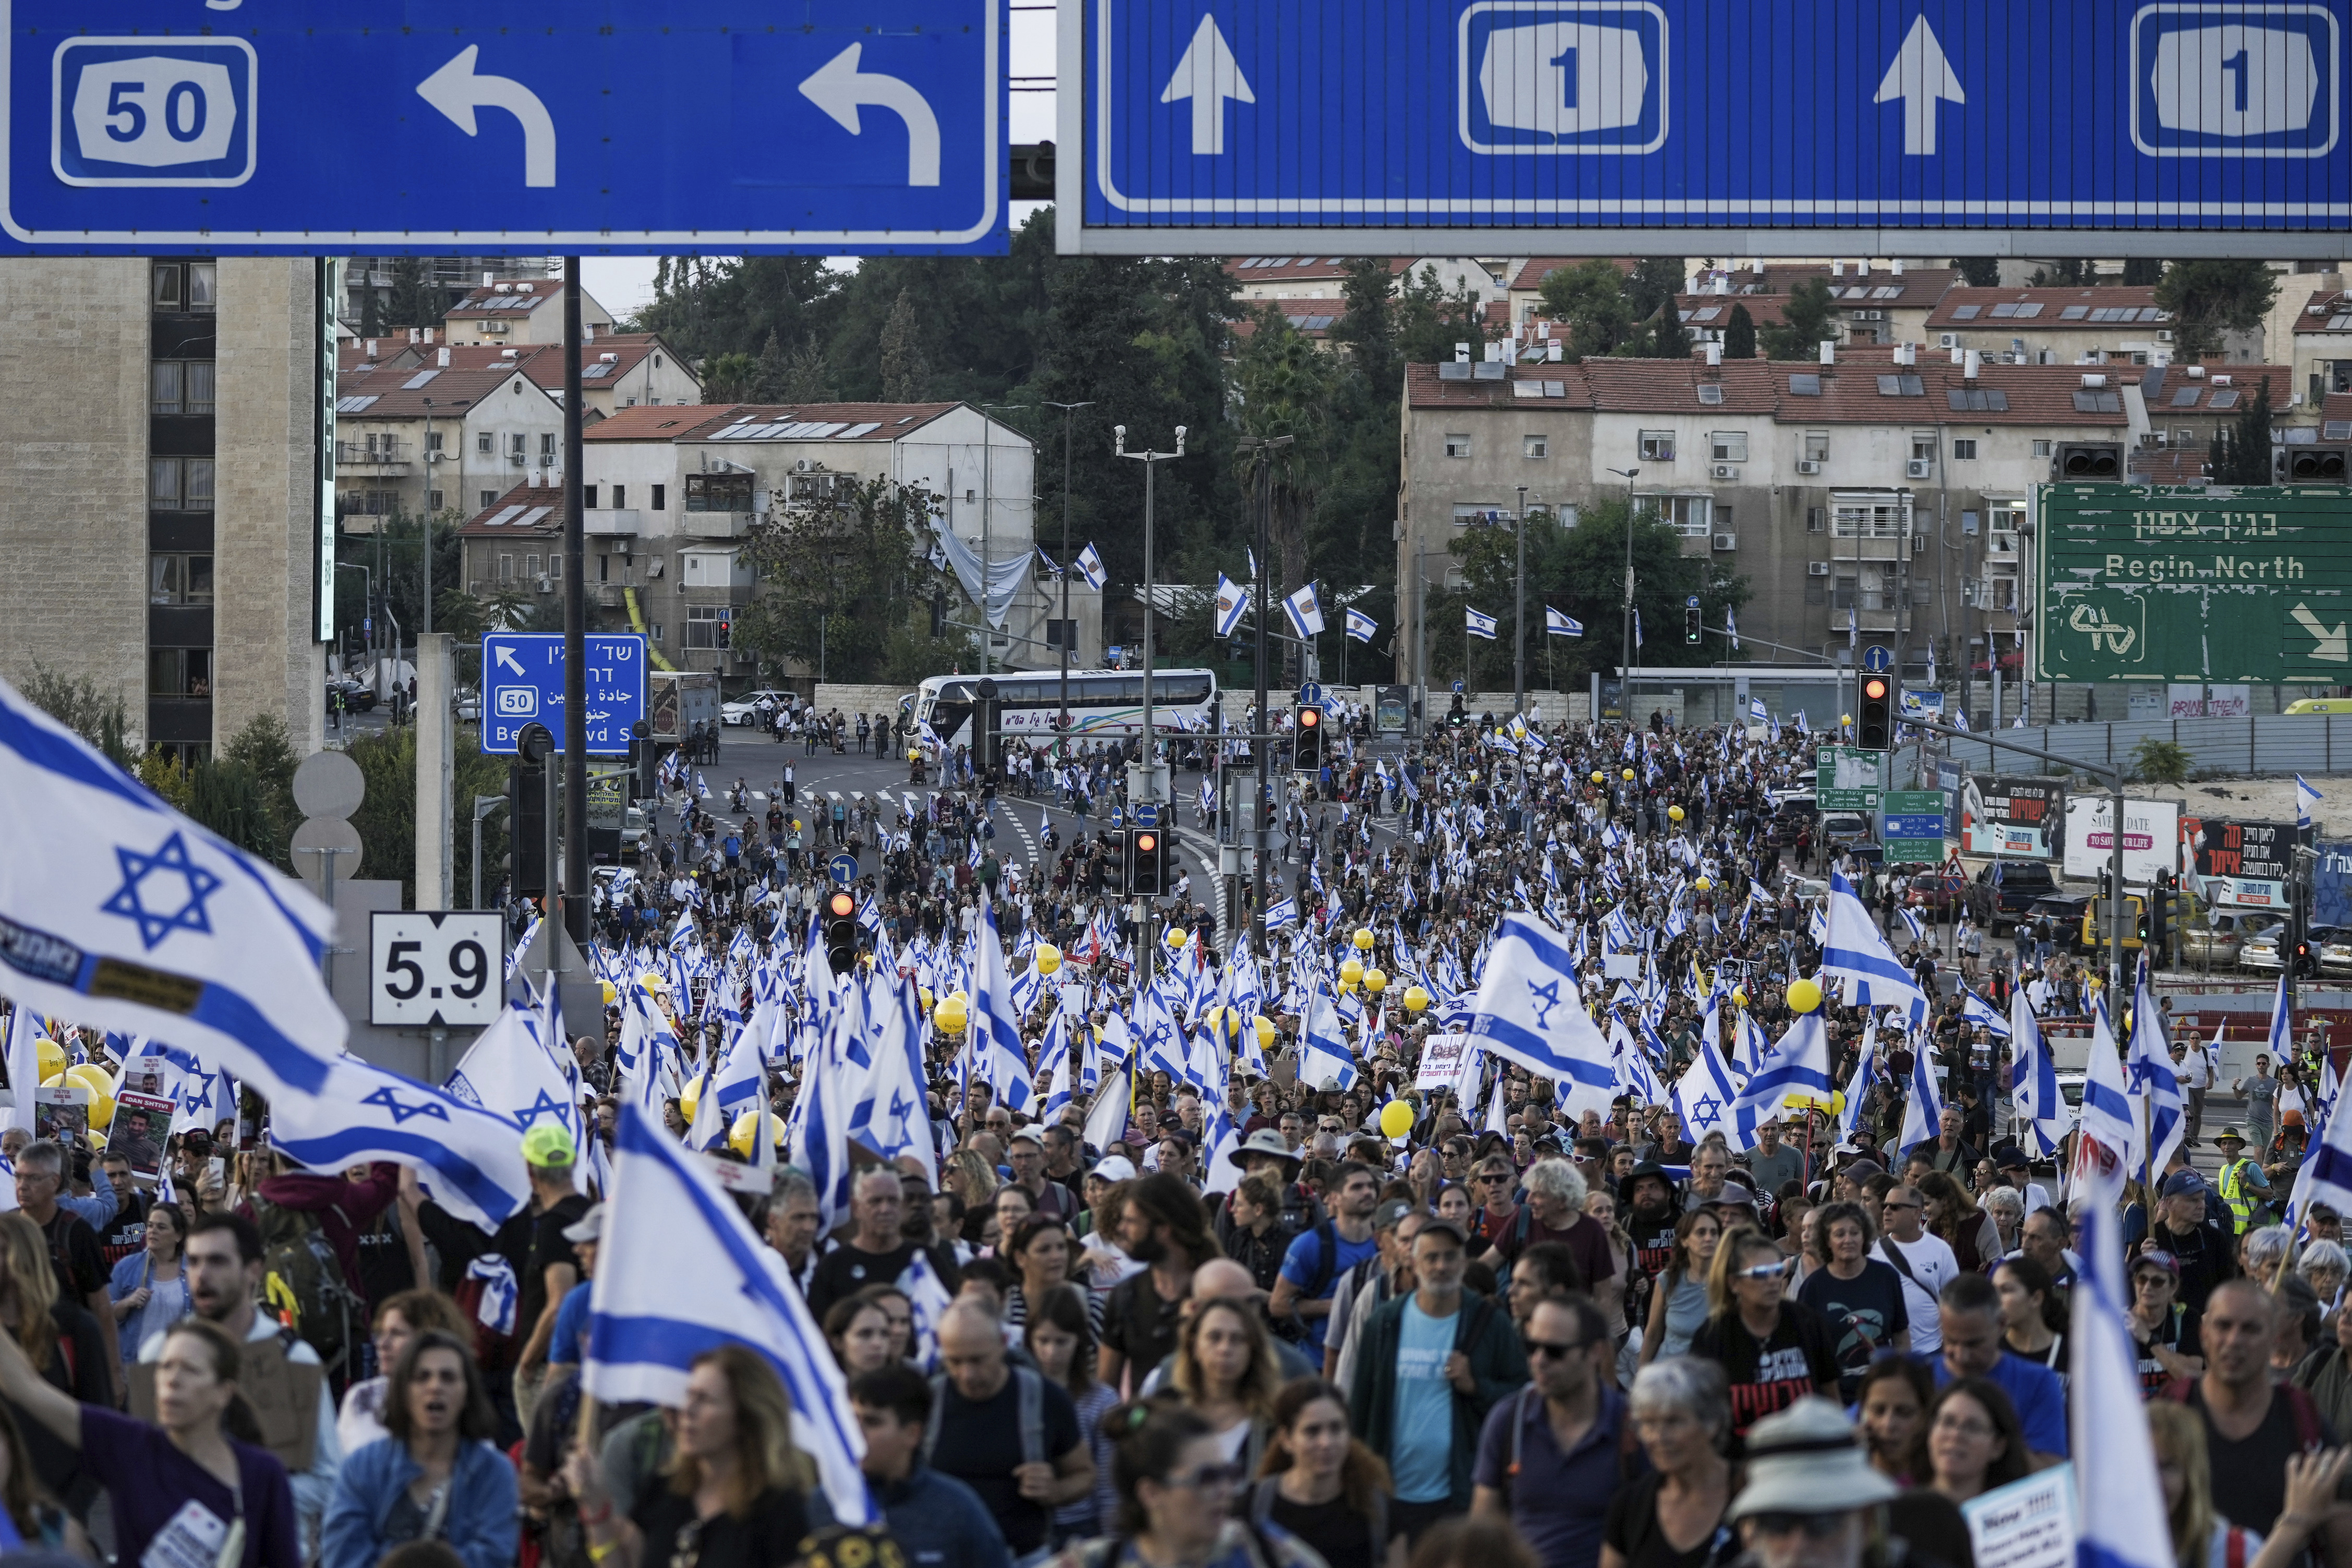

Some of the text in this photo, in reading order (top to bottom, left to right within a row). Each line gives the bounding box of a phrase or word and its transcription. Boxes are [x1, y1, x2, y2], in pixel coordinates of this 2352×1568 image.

[1550, 46, 1578, 109] 1
[2221, 49, 2249, 113] 1
[105, 80, 208, 143] 50
[2133, 512, 2278, 540] בגין צפון
[2106, 554, 2304, 583] Begin North
[506, 694, 528, 708] 50
[599, 689, 632, 704] جادة
[2209, 699, 2244, 715] THEM
[586, 708, 611, 725] جنو
[2010, 799, 2045, 820] ישחיתו
[2091, 814, 2150, 831] SAVE DATE
[2091, 836, 2100, 845] TO
[2122, 837, 2133, 847] OUR
[2133, 838, 2149, 848] LIFE
[2224, 825, 2241, 849] מה
[2244, 826, 2275, 843] ליאון חייב
[2243, 844, 2270, 859] את חגית
[2209, 849, 2241, 876] איתך
[2270, 861, 2283, 877] לידו
[2244, 883, 2257, 894] משה
[2258, 884, 2271, 895] חגית
[385, 939, 488, 1000] 5.9
[49, 1058, 58, 1067] Bring
[125, 1096, 169, 1109] IDAN SHTIVI
[111, 1234, 132, 1245] הביתה
